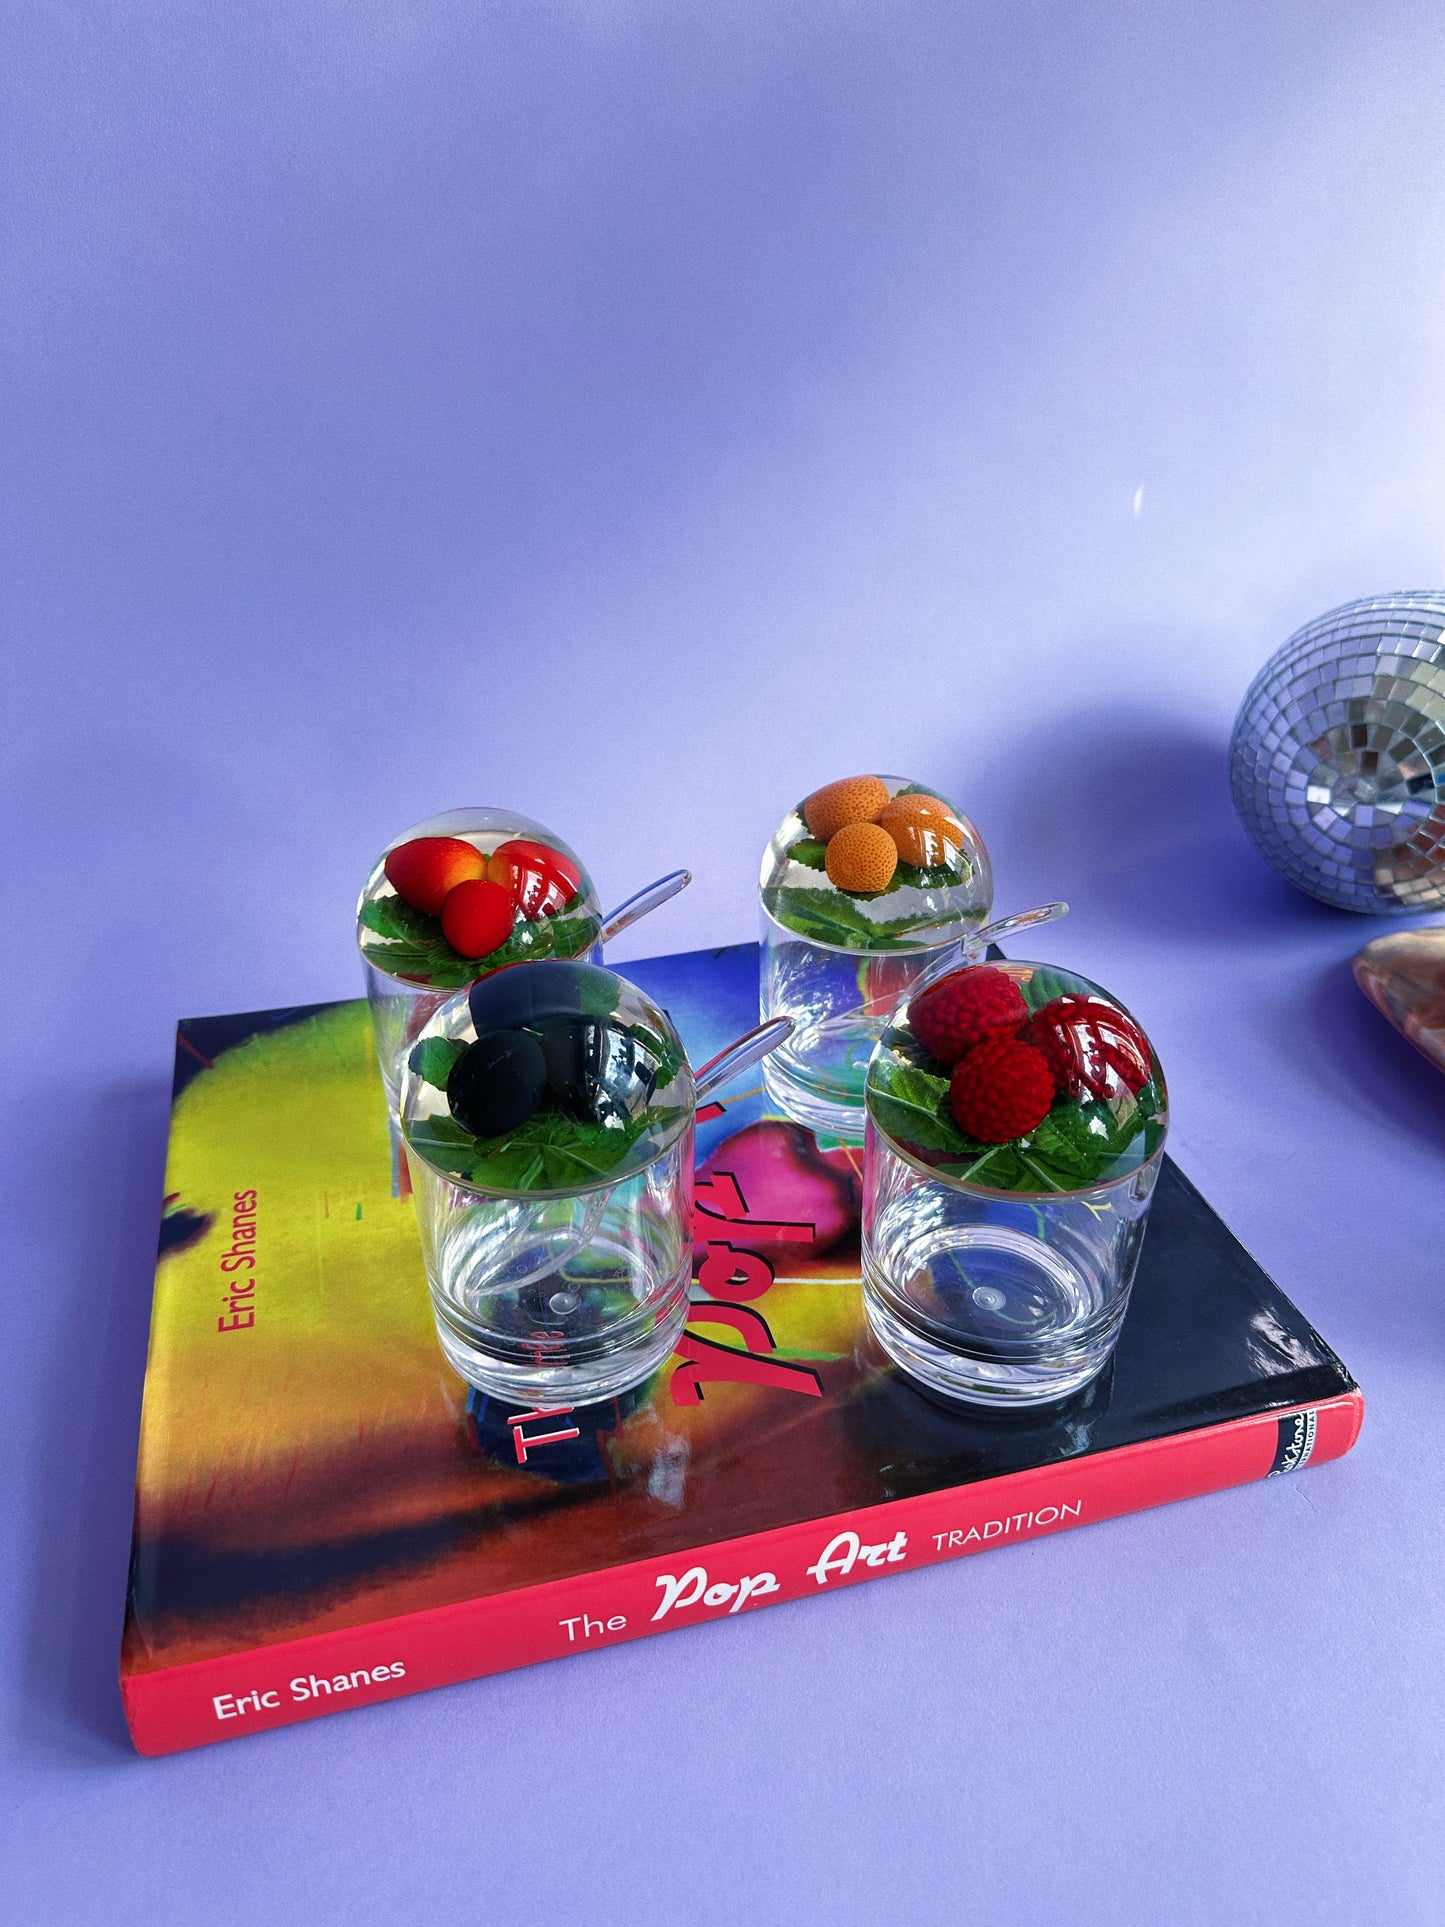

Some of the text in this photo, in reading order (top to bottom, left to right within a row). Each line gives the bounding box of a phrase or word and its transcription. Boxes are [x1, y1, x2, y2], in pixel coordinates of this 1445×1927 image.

[218, 1189, 257, 1332] Eric Shanes
[559, 1500, 1082, 1641] The Pop Art TRADITION
[212, 1661, 406, 1720] Eric Shanes
